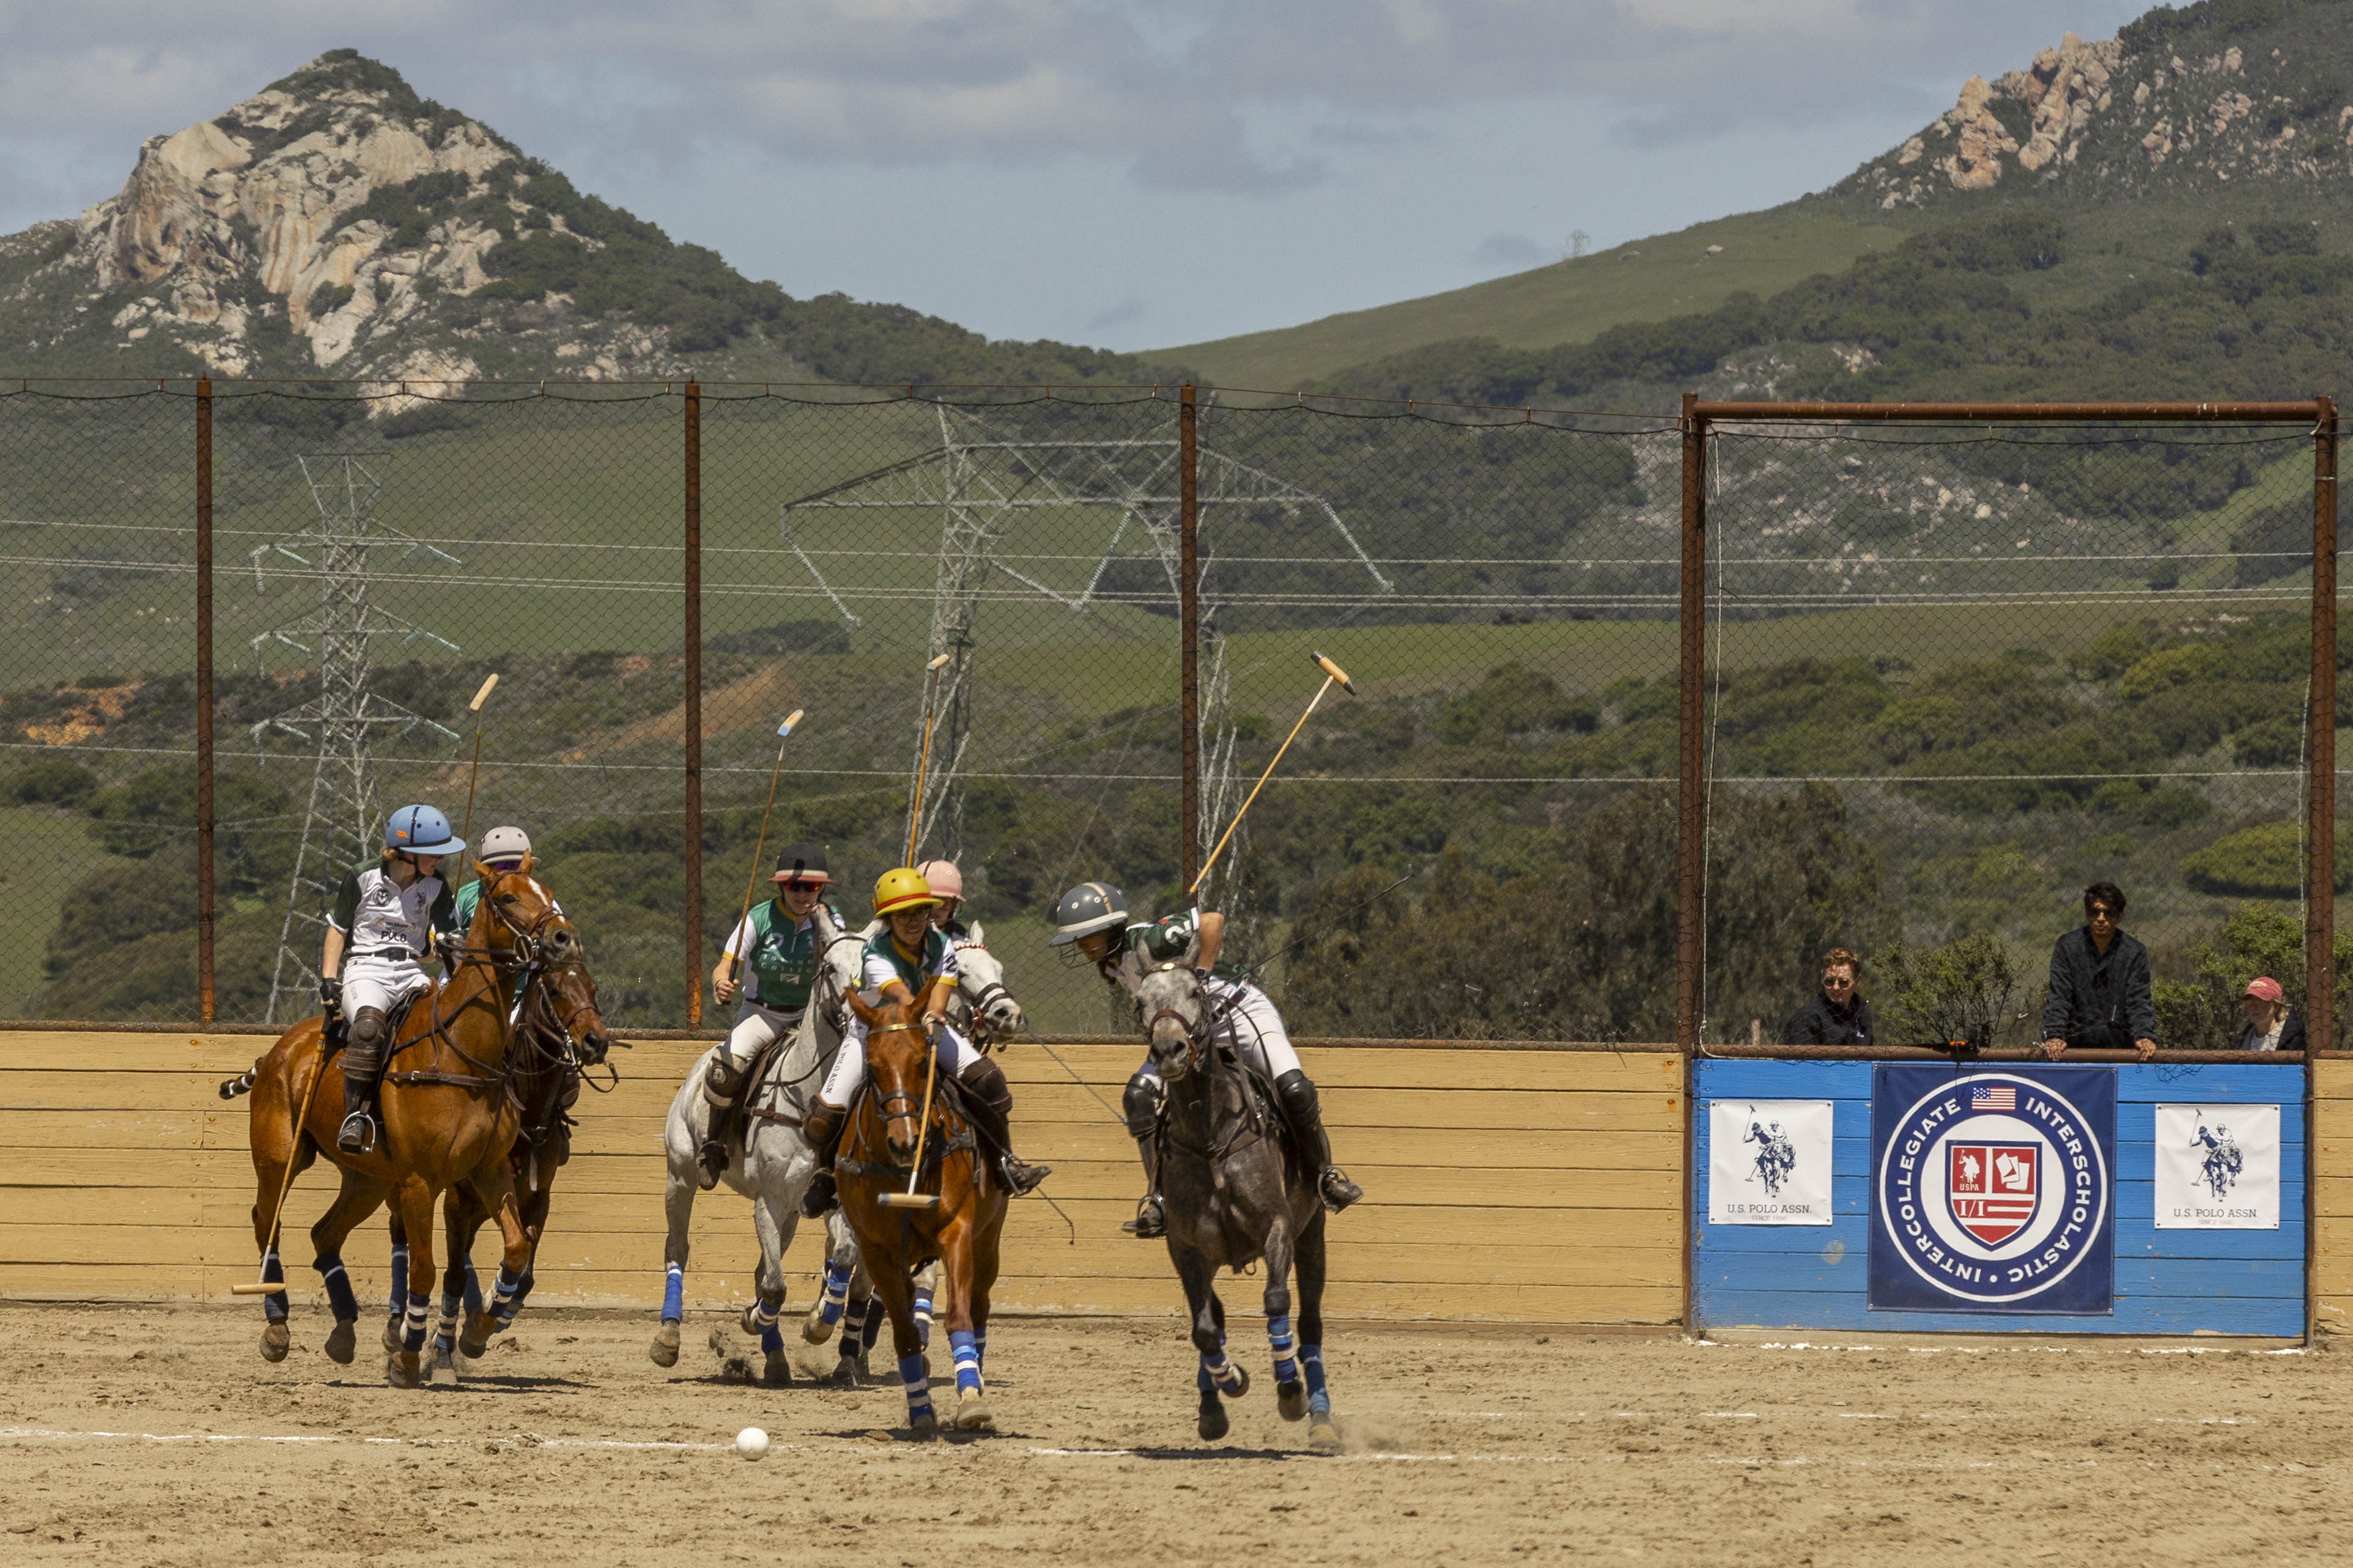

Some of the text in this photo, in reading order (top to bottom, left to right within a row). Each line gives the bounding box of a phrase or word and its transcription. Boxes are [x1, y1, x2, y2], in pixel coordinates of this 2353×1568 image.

[944, 954, 958, 973] 2
[1898, 1098, 1982, 1283] INTERCOLLEGIATE
[2008, 1097, 2091, 1282] INTERSCHOLASTIC
[1727, 1204, 1812, 1213] U.S. POLO ASSN.
[2173, 1208, 2192, 1218] U.S.
[2196, 1209, 2225, 1218] POLO
